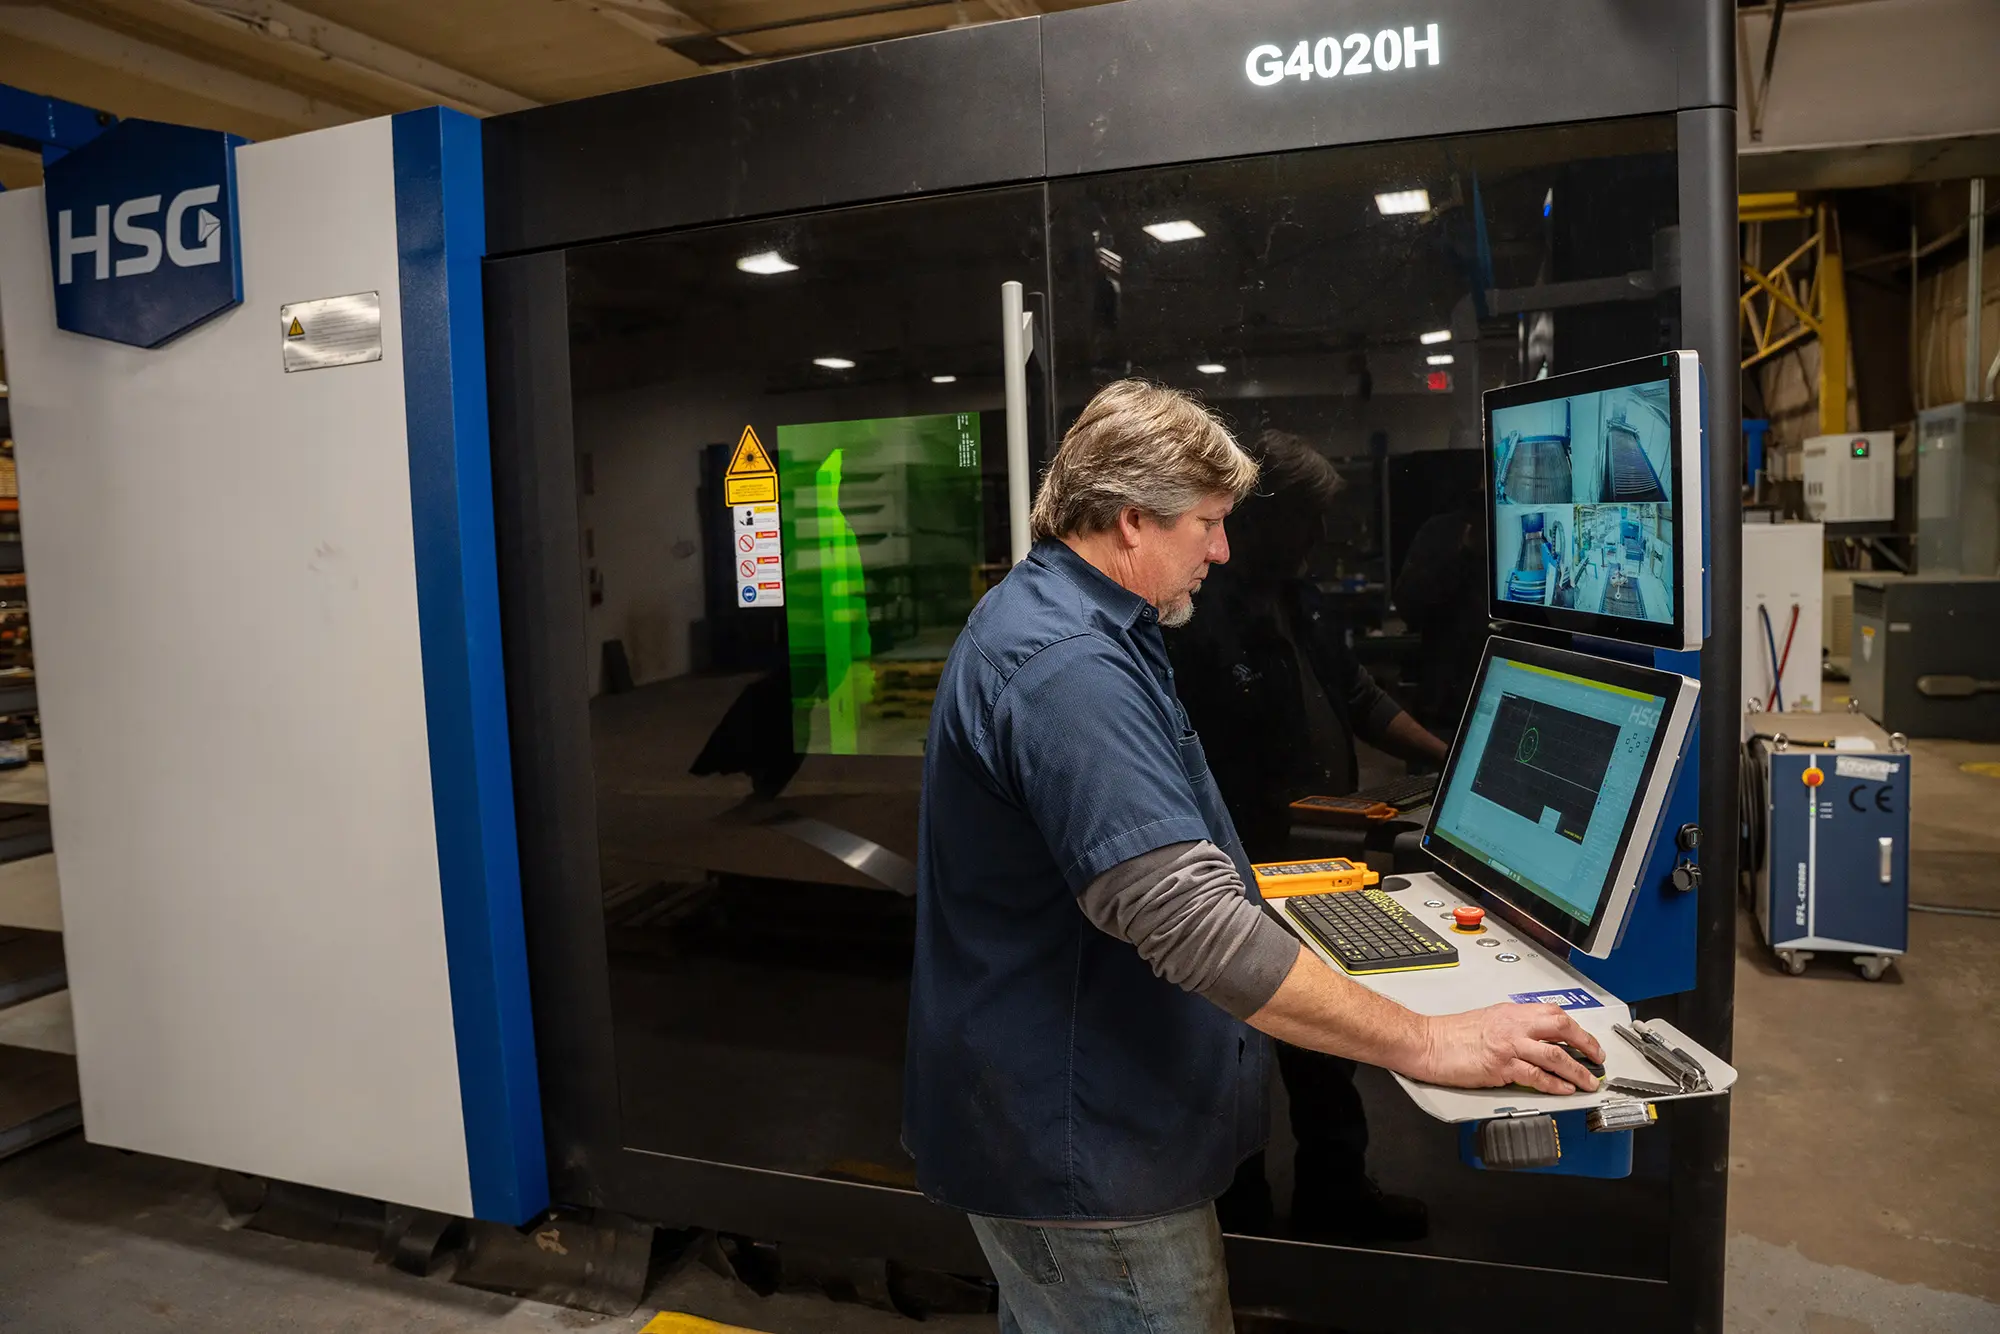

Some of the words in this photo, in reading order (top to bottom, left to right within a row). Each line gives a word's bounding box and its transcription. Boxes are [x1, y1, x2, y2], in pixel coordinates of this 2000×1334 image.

[1245, 23, 1440, 86] G4020H
[58, 184, 221, 285] HSG
[1848, 784, 1893, 813] CE
